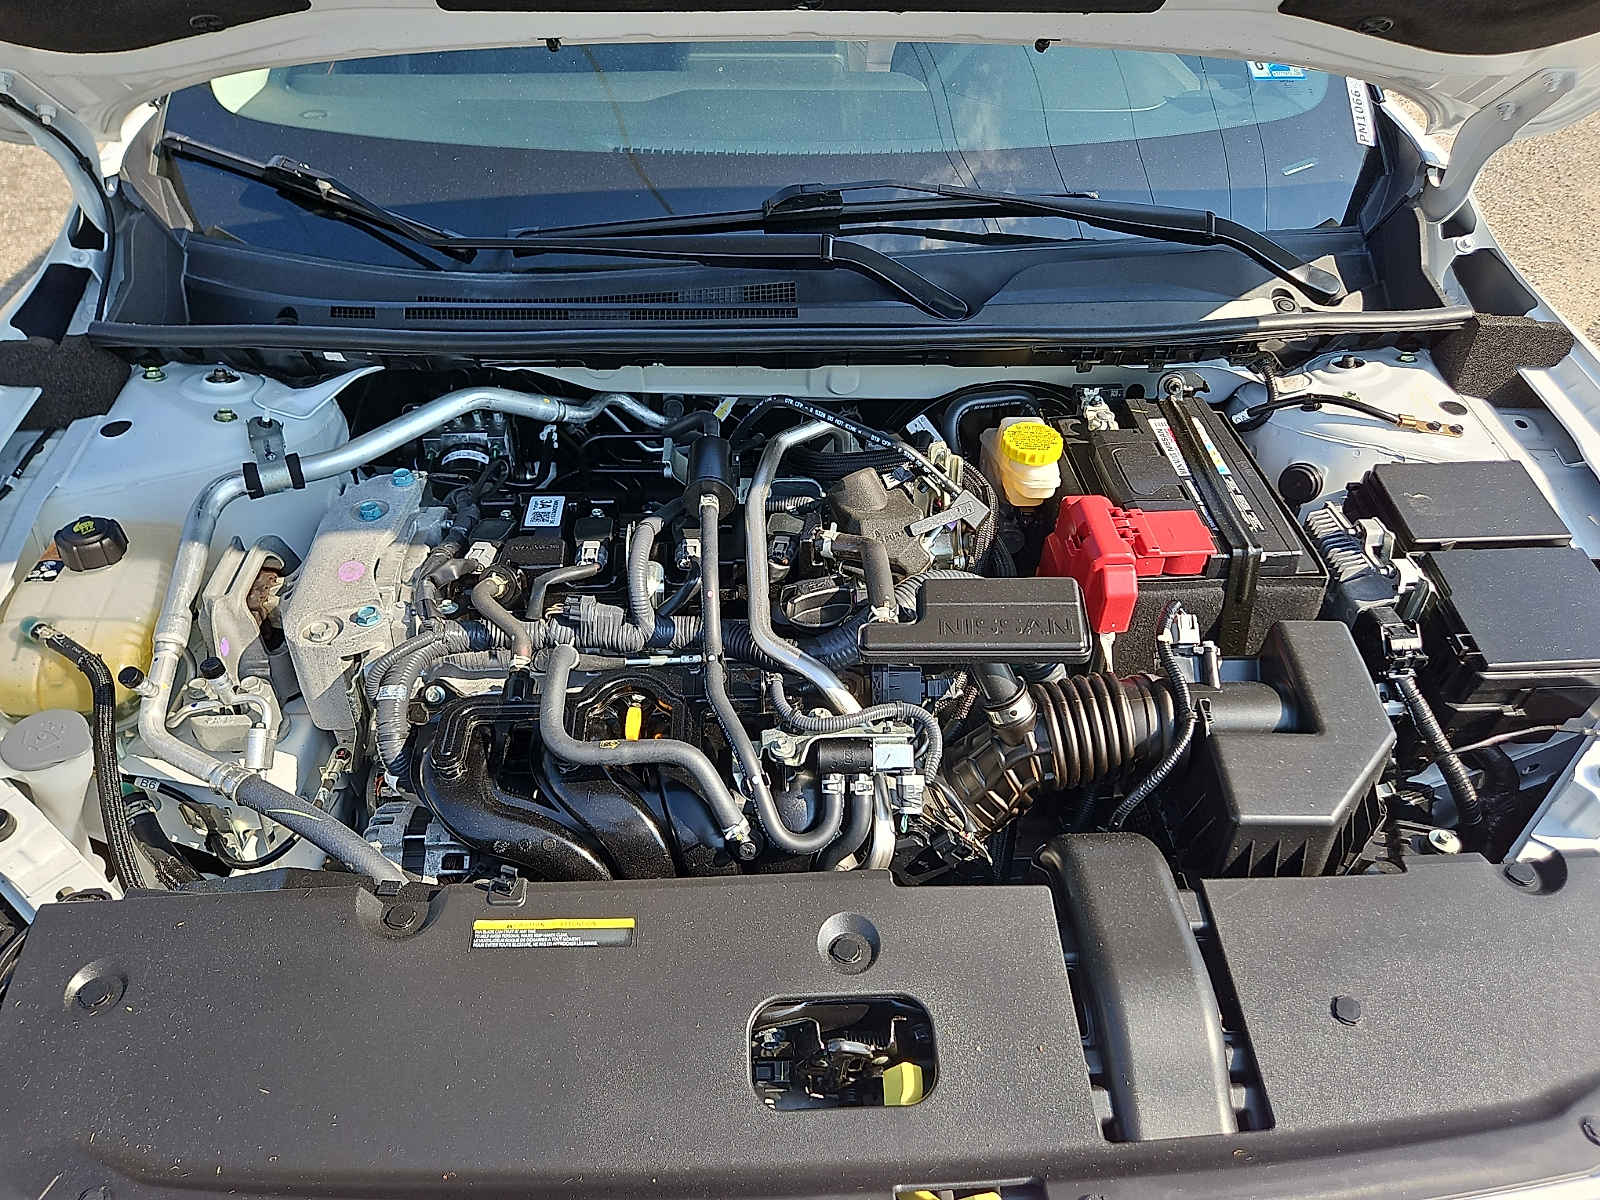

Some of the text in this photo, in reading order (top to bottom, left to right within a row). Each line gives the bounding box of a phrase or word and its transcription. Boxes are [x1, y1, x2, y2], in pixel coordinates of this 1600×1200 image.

[1156, 429, 1174, 452] NISSAN
[938, 617, 1075, 636] NISSAN
[140, 778, 157, 790] B6
